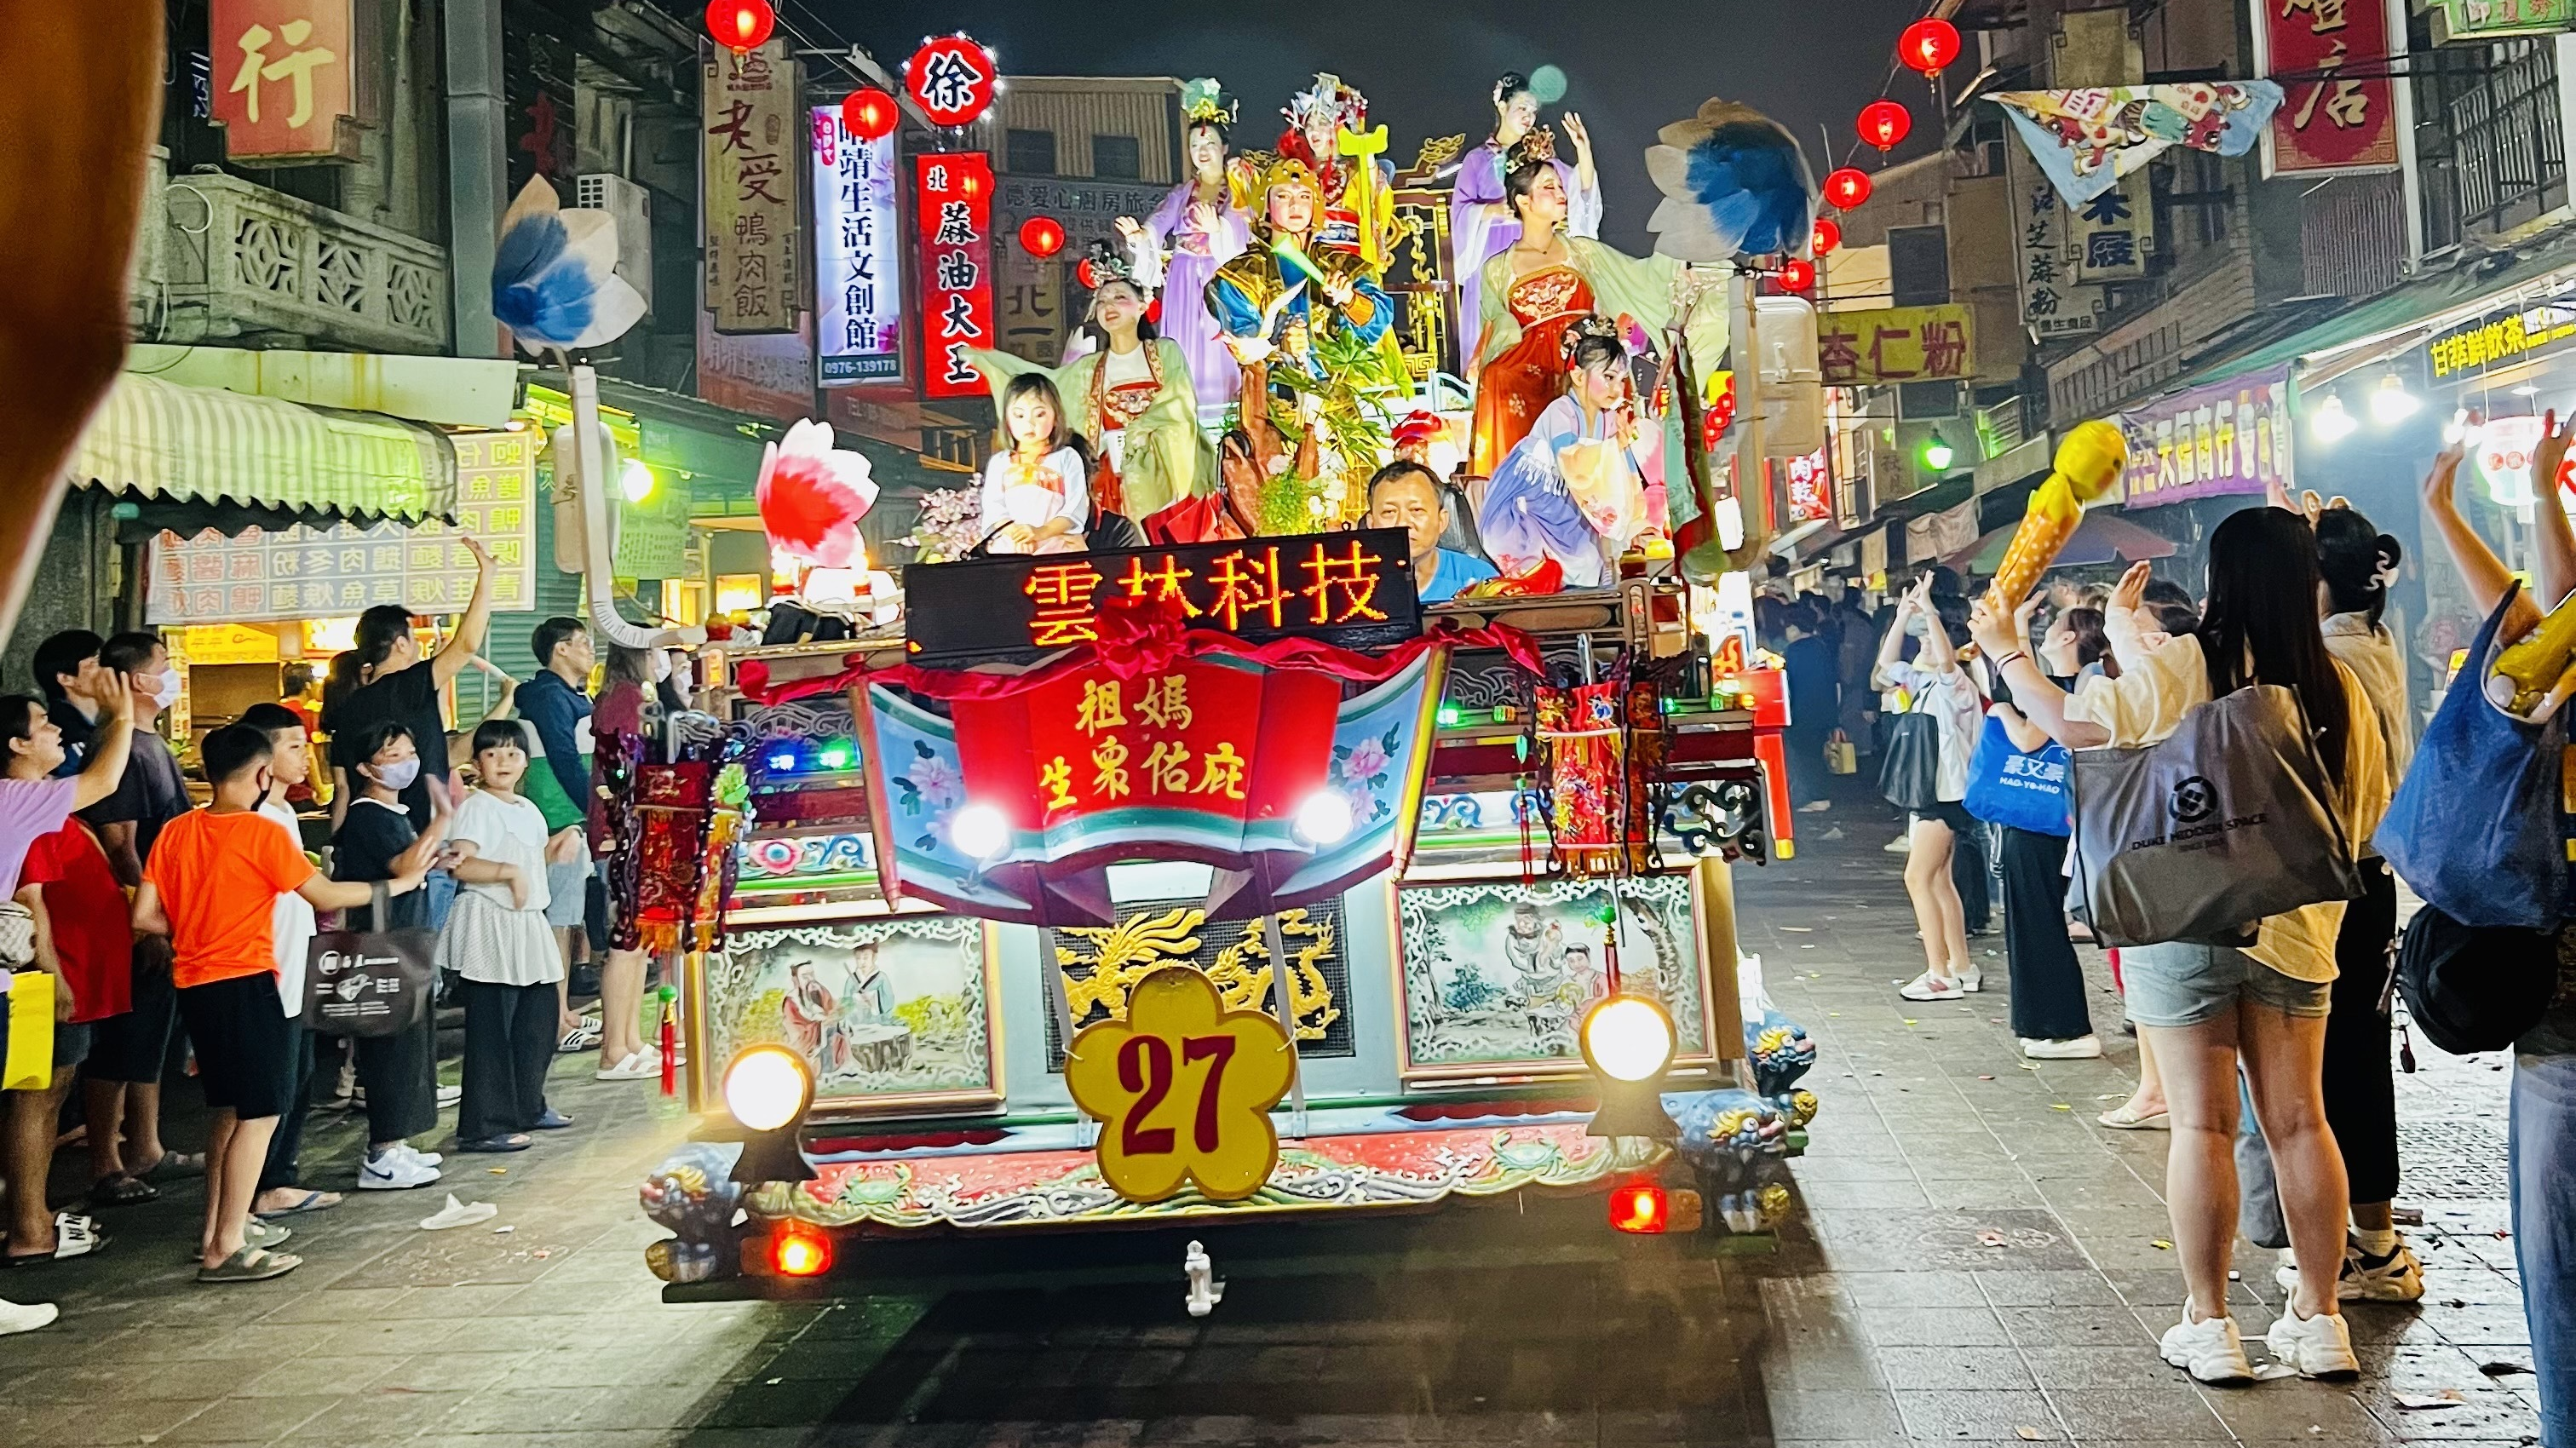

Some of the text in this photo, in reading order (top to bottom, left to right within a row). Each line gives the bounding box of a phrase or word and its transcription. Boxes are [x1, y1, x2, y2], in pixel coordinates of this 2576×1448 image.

[228, 19, 336, 129] 行
[923, 53, 980, 109] 徐
[825, 359, 897, 373] 0976-139178
[1819, 320, 1966, 381] 杏仁粉
[1025, 541, 1389, 646] 雲林科技
[1118, 1035, 1236, 1157] 27
